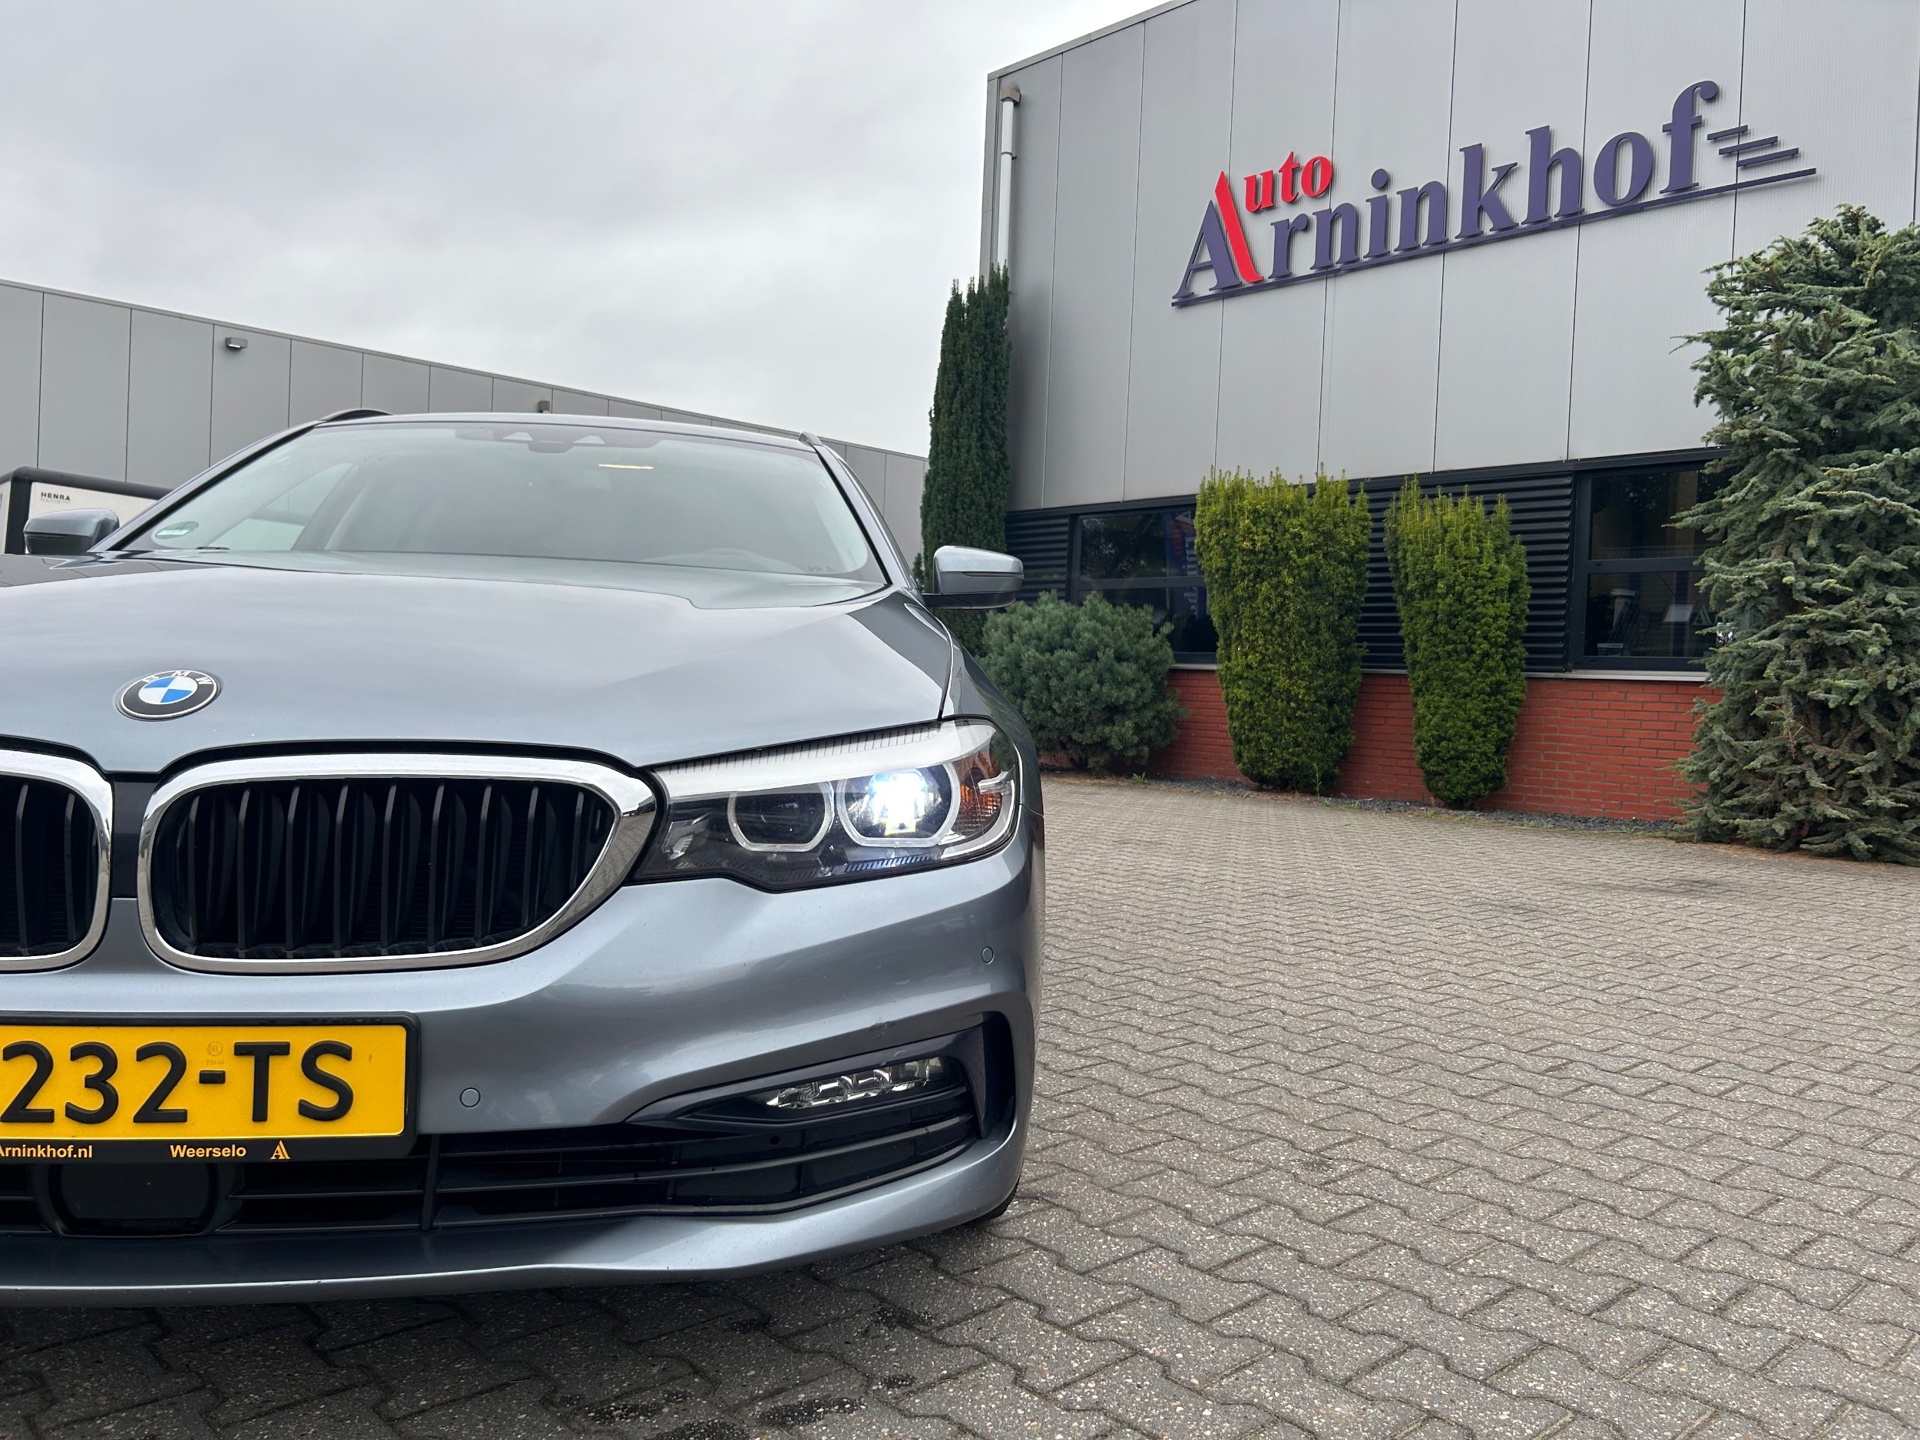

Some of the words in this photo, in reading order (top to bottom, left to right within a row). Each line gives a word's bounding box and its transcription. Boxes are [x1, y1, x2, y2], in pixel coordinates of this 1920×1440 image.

[1172, 80, 1720, 301] Arninkhof
[40, 491, 71, 502] HENRA
[140, 670, 214, 685] BMW
[0, 1040, 354, 1124] 232-TS
[170, 1144, 247, 1158] Weerselo
